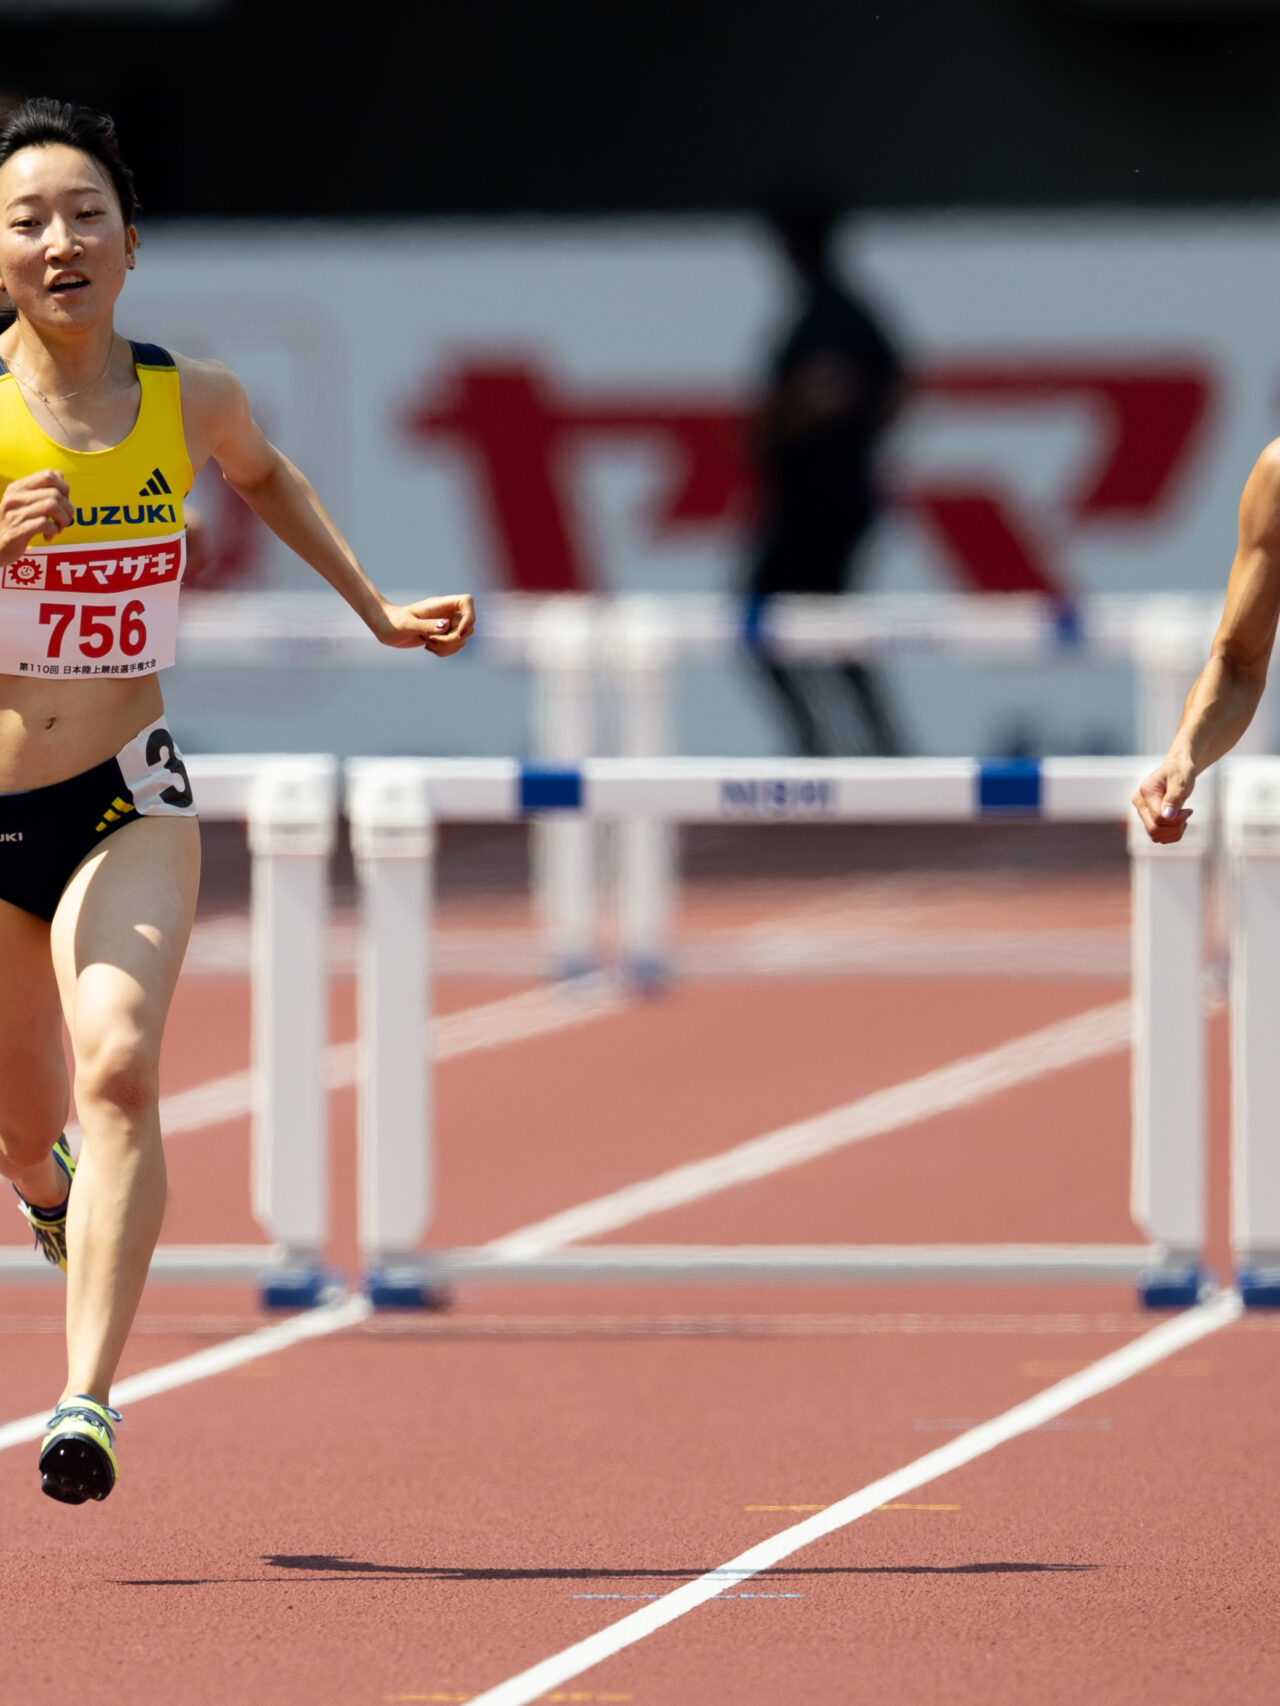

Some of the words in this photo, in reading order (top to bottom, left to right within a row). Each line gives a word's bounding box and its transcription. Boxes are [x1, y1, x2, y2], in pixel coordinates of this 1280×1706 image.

[66, 504, 176, 527] UZUKI
[56, 552, 175, 585] ヤマザキ
[39, 600, 147, 658] 756
[19, 662, 59, 675] 第110回
[63, 658, 157, 675] 日本陸上競技選手権大会
[146, 728, 193, 808] 3
